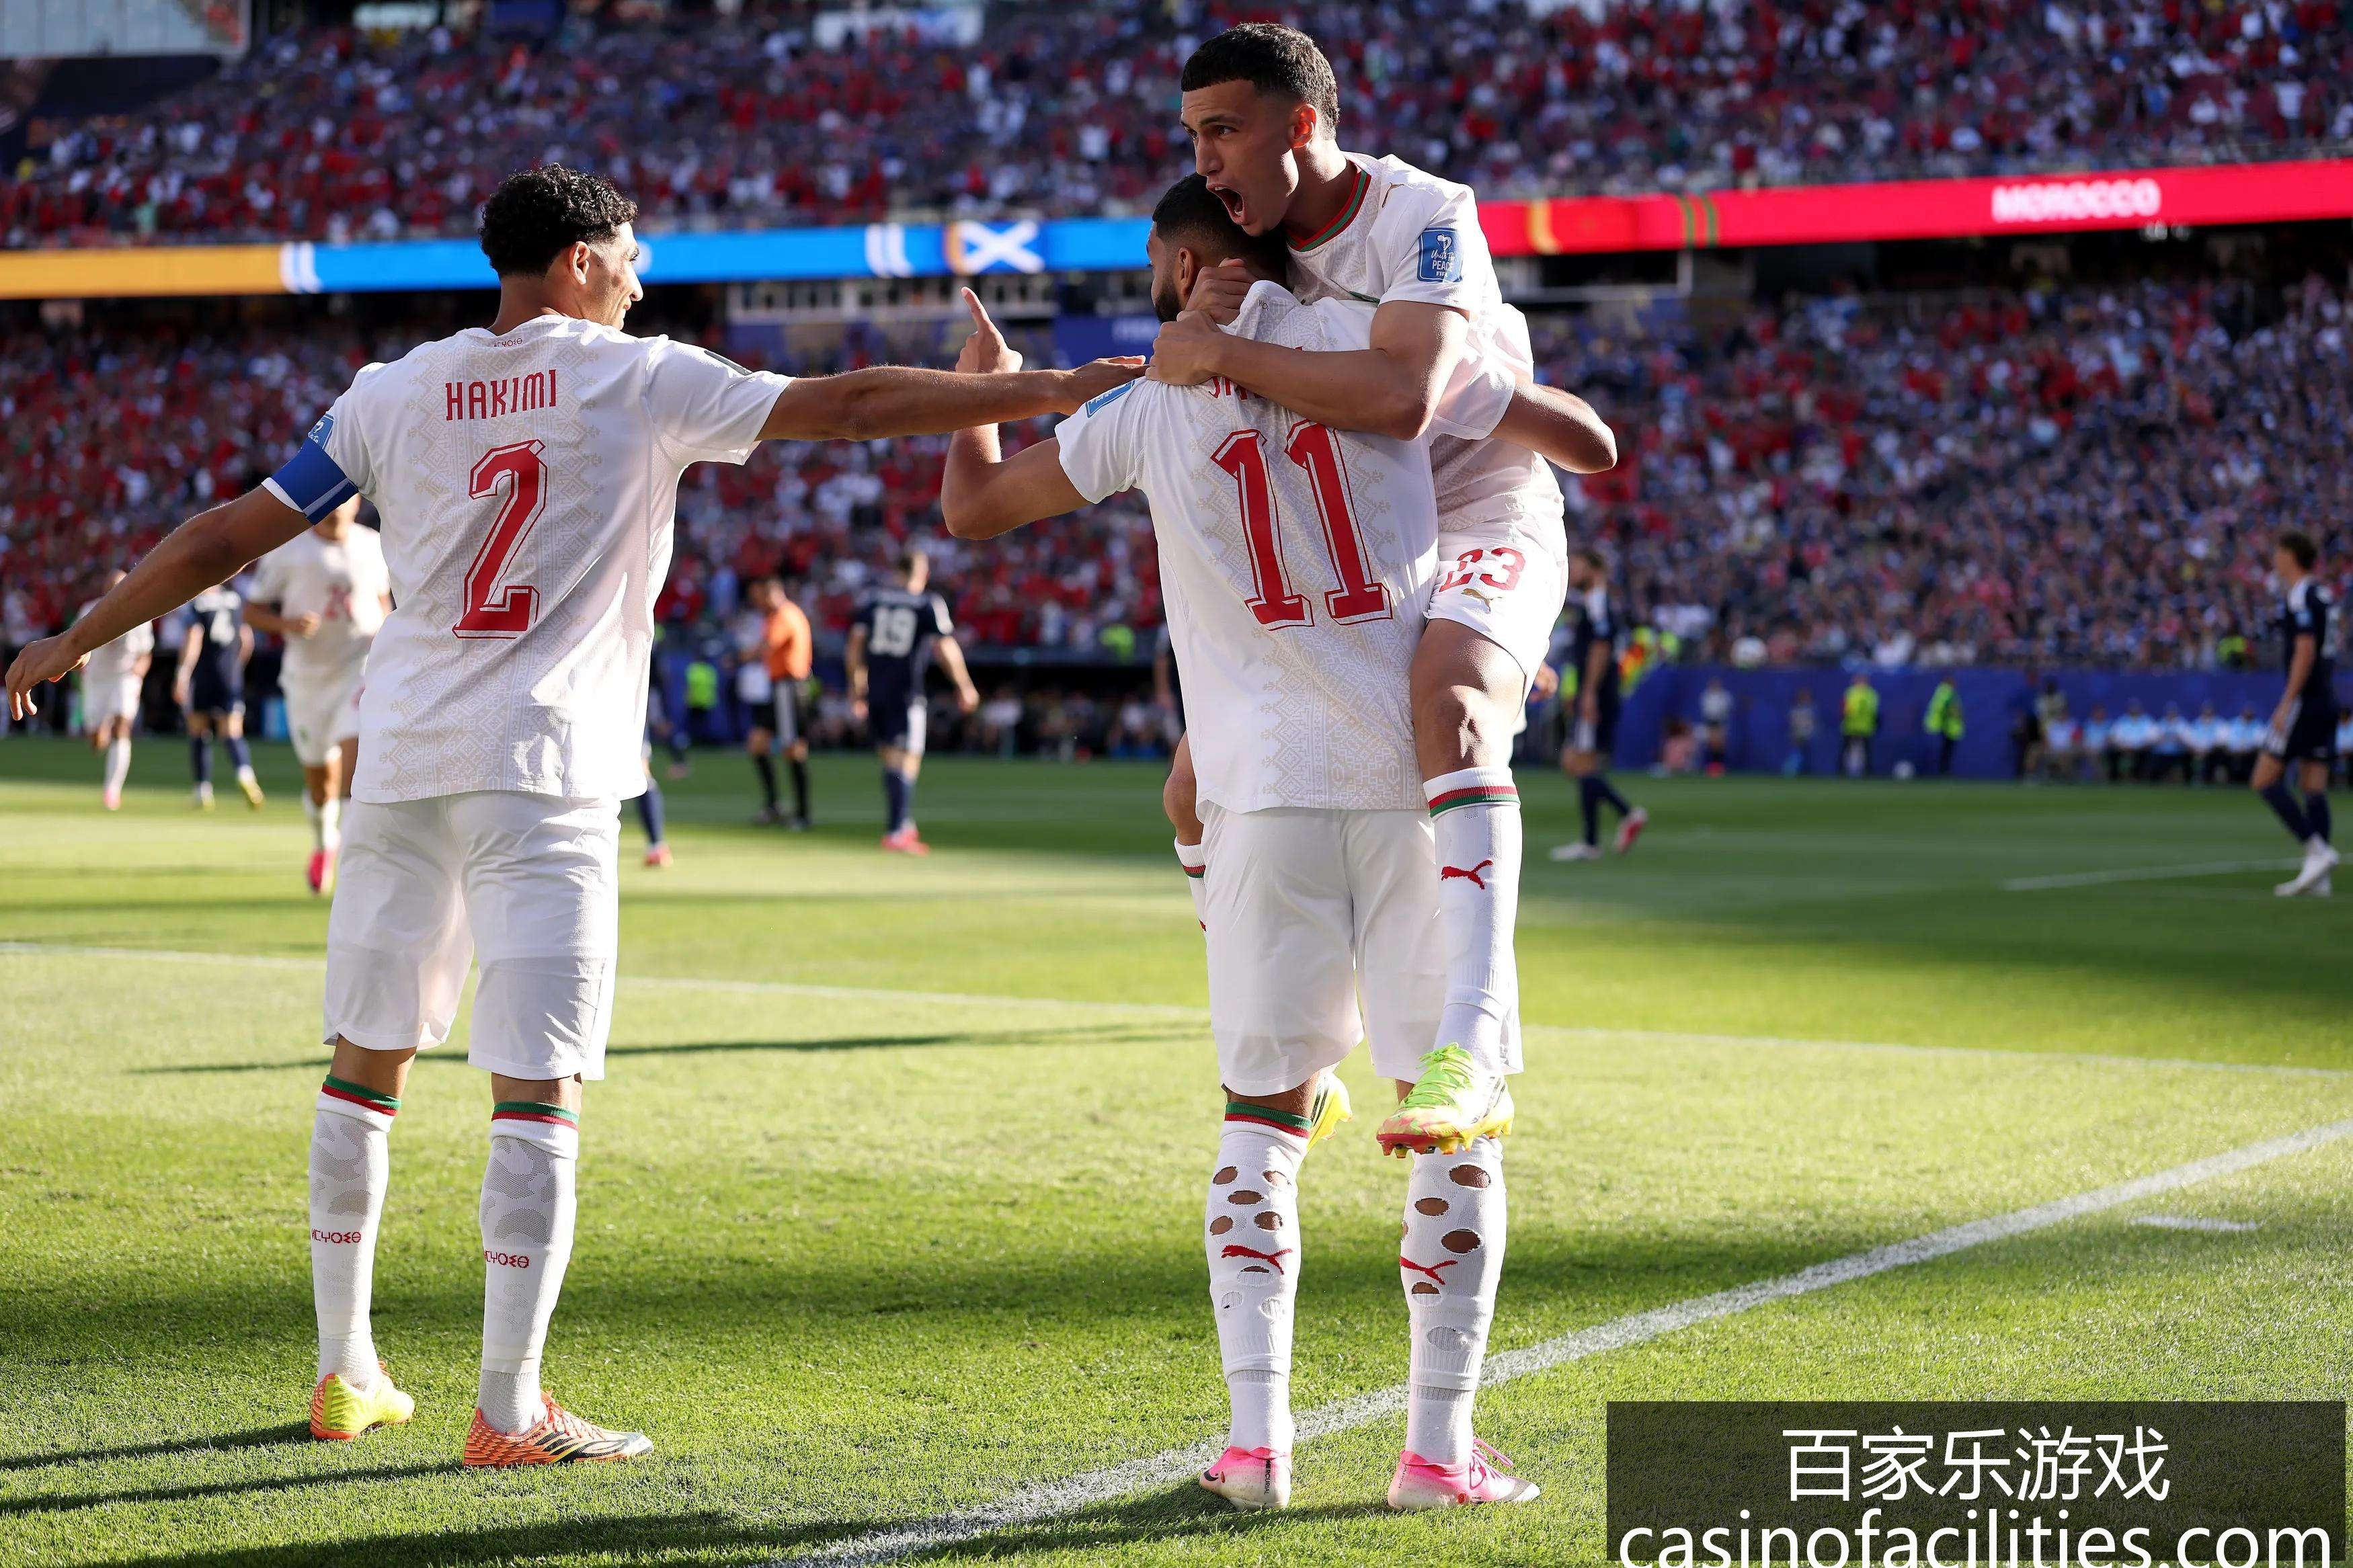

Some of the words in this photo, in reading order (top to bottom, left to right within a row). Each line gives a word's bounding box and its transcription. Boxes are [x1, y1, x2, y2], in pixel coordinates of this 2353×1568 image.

[1992, 179, 2161, 223] MOROCCO
[446, 369, 557, 421] HAKIMI
[452, 439, 547, 638] 2
[1210, 419, 1393, 631] 11
[1439, 547, 1525, 592] 23
[209, 608, 236, 645] 4
[869, 606, 917, 657] 19
